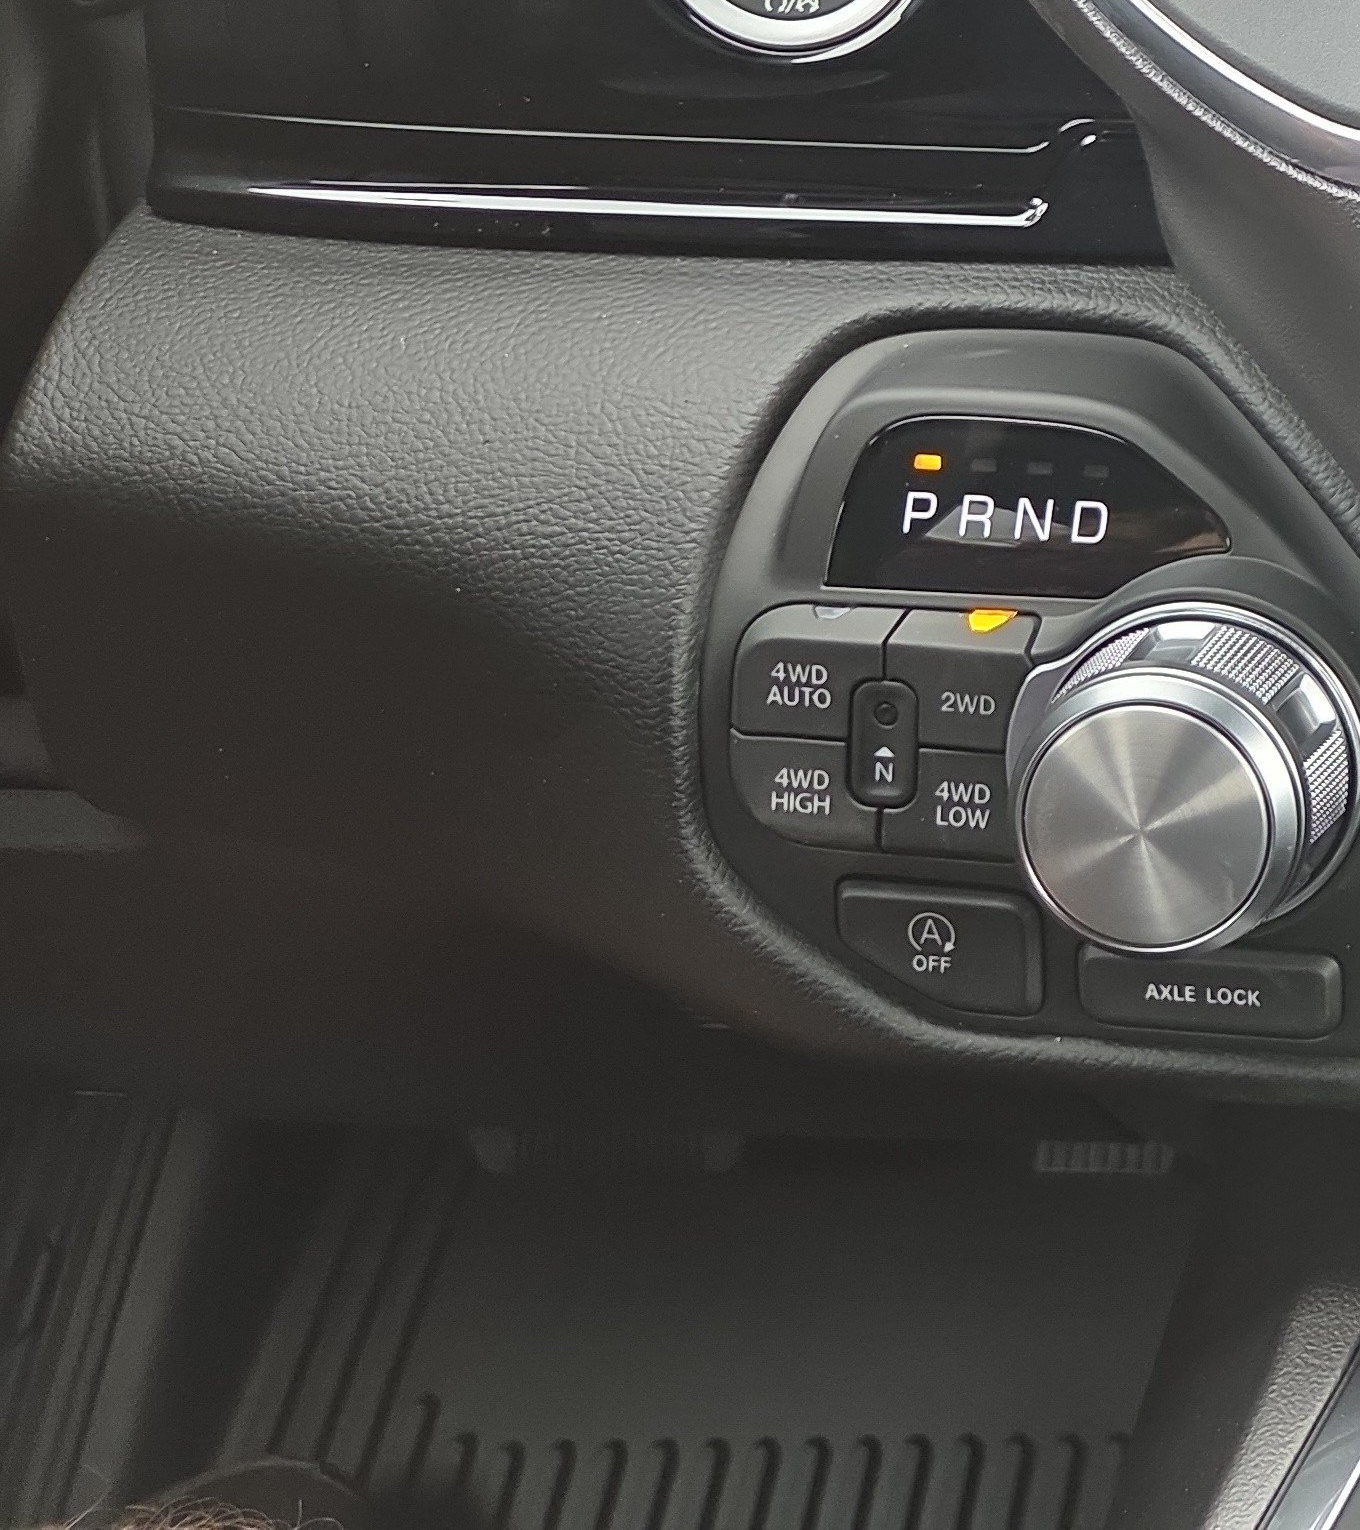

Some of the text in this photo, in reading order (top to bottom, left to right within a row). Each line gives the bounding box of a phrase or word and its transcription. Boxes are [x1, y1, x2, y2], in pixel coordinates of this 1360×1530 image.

[771, 661, 828, 685] 4WD
[766, 686, 832, 709] AUTO
[941, 692, 996, 715] 2WD
[774, 768, 830, 791] 4WD
[874, 761, 894, 783] N
[770, 791, 831, 815] HIGH
[934, 782, 991, 806] 4WD
[935, 805, 990, 829] LOW
[912, 954, 951, 973] OFF
[1145, 983, 1261, 1008] AXLE LOCK
